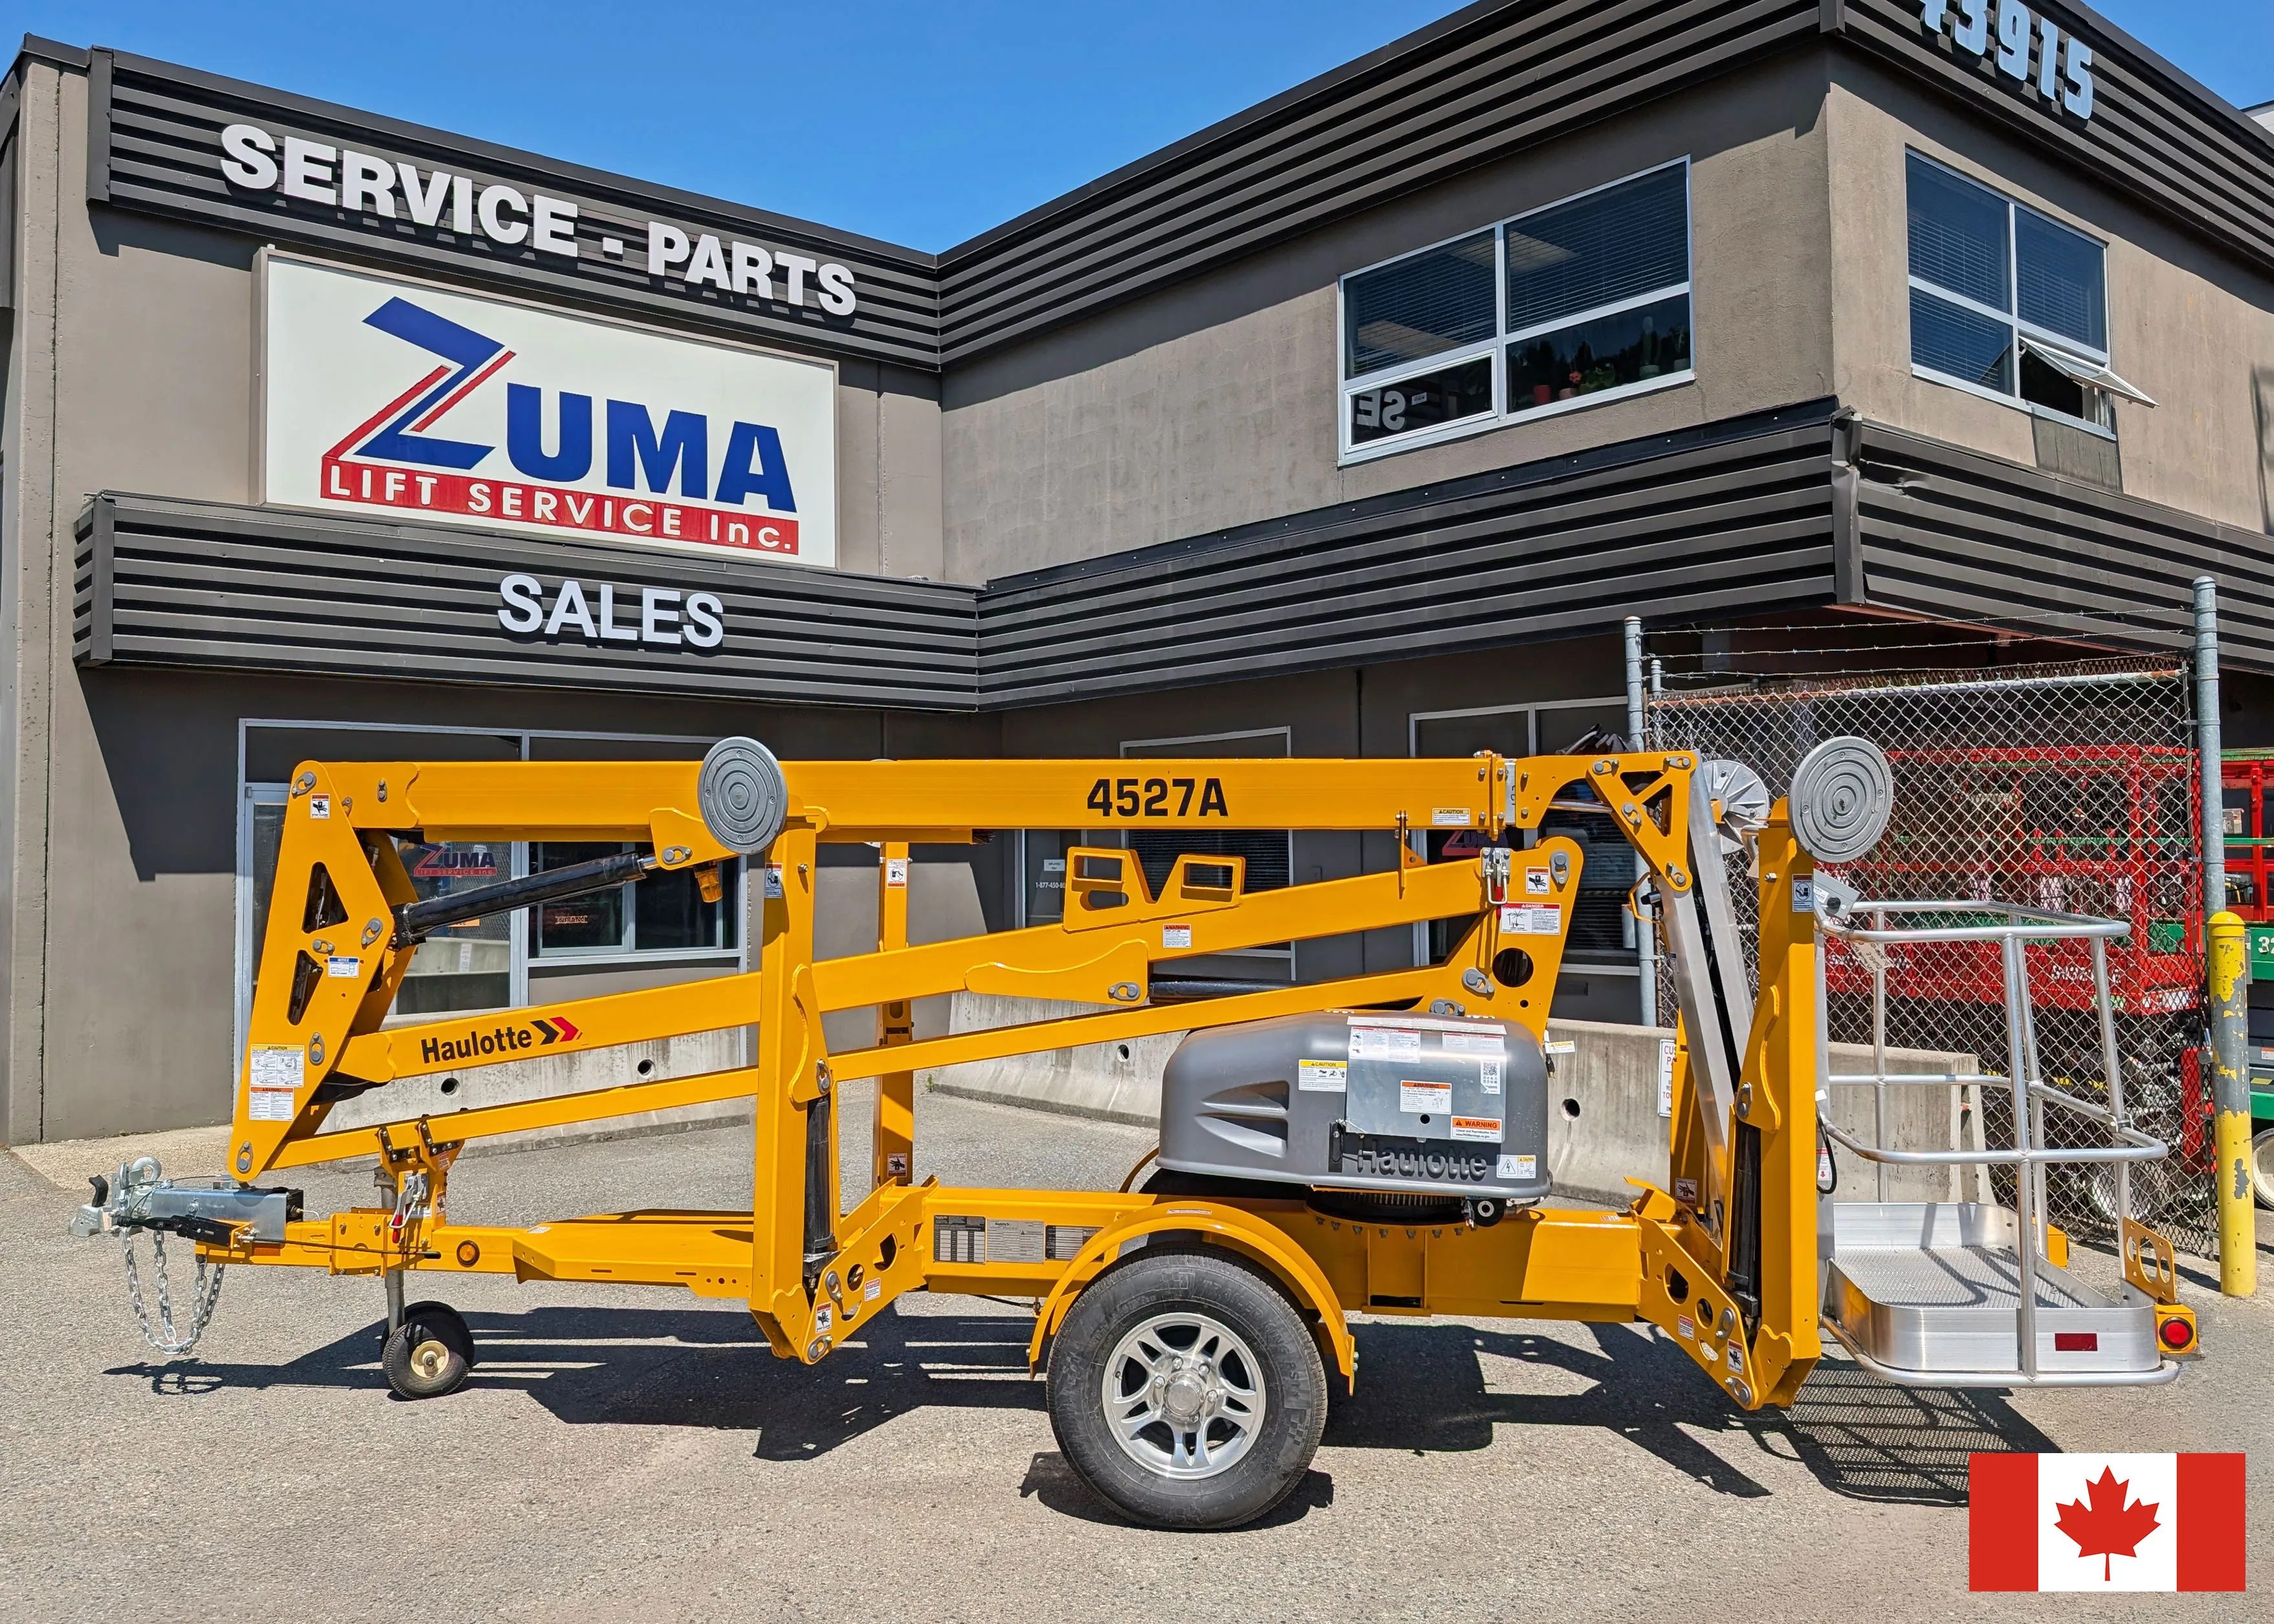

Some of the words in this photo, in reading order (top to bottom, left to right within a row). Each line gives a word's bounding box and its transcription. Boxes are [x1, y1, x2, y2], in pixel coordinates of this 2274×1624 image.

[219, 123, 579, 258] SERVICE
[647, 220, 857, 317] PARTS
[322, 296, 798, 514] ZUMA
[329, 463, 440, 509] LIFT
[467, 481, 683, 539] SERVICE
[709, 513, 792, 550] Inc.
[497, 573, 724, 649] SALES
[1087, 777, 1229, 818] 4527A
[415, 843, 496, 869] ZUMA
[421, 1027, 532, 1064] Haulotte
[1465, 1120, 1497, 1129] WARNING
[1357, 1140, 1488, 1177] Haulotte
